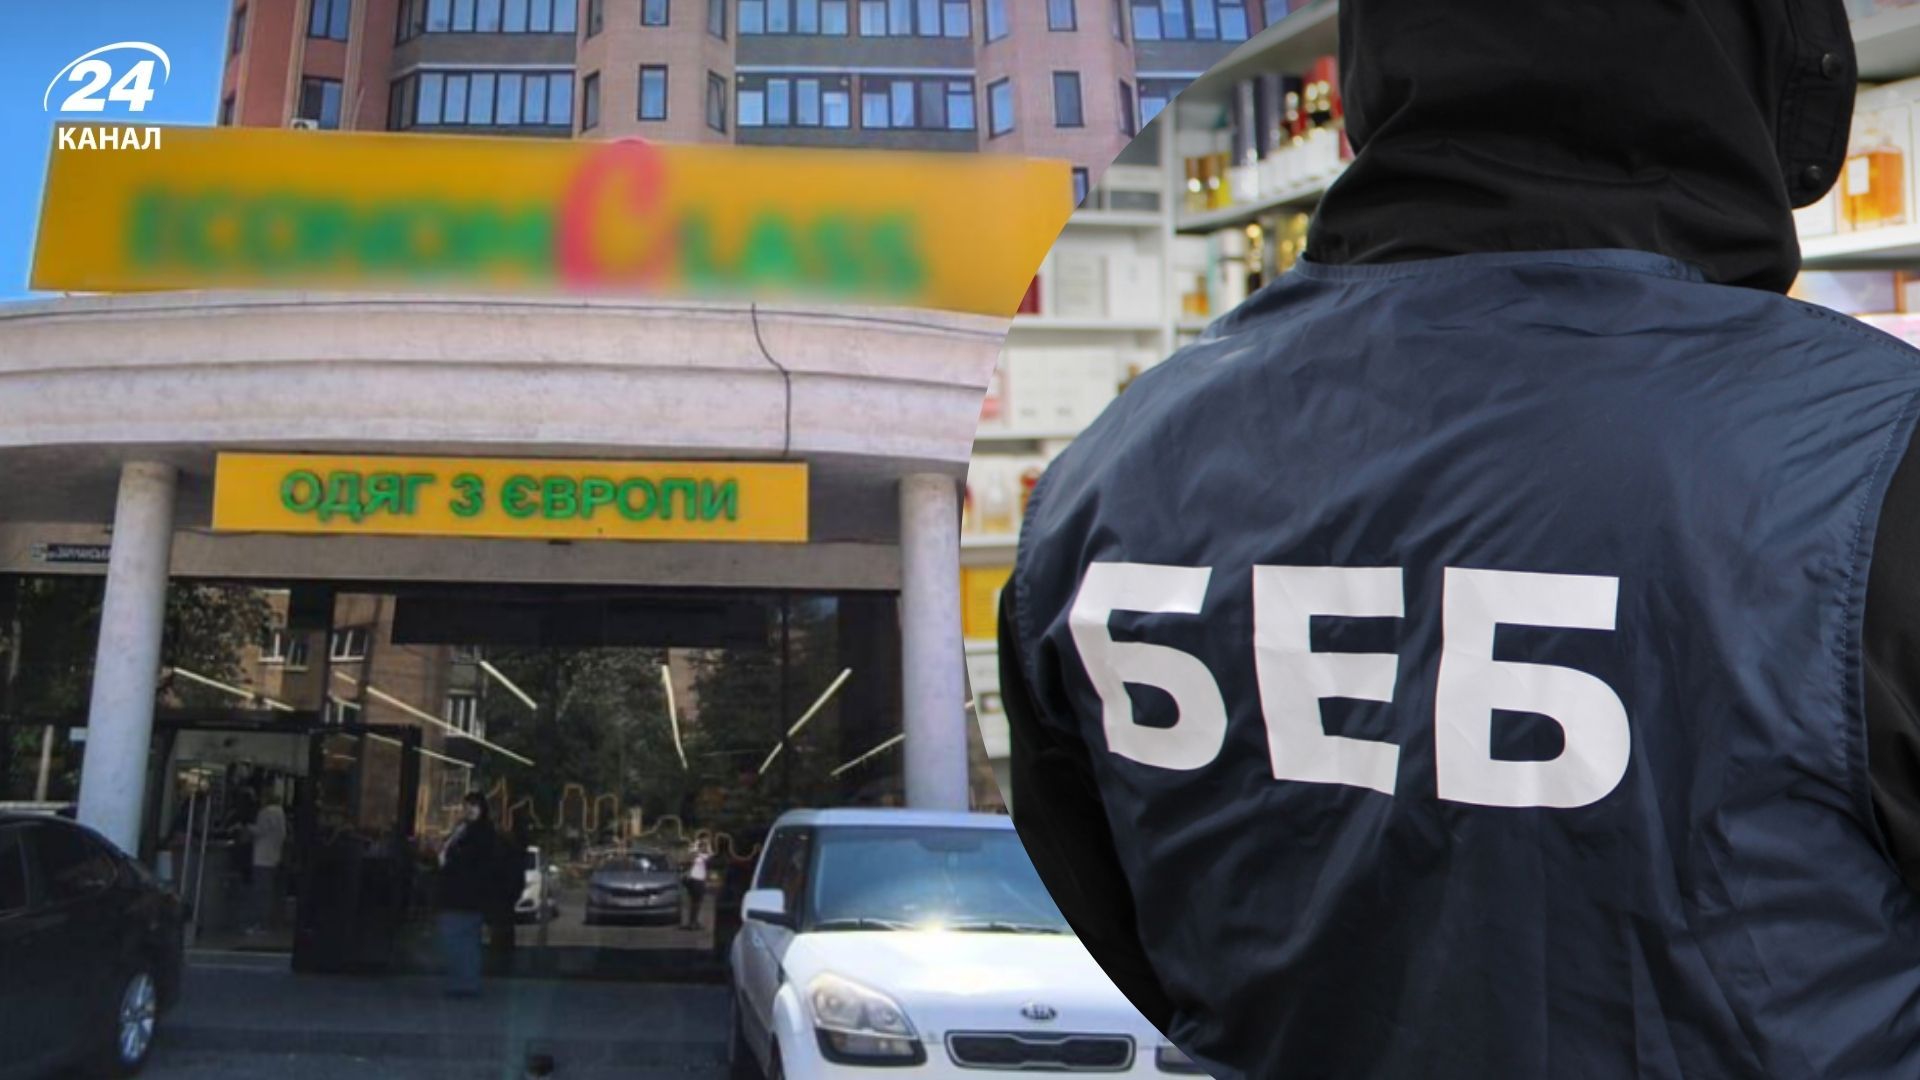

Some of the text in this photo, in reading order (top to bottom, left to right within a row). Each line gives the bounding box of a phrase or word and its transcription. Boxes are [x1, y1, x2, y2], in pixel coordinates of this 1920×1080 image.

[279, 470, 436, 522] ОДЯГ
[501, 474, 739, 522] ЄВРОПИ
[1069, 561, 1632, 809] БЕБ
